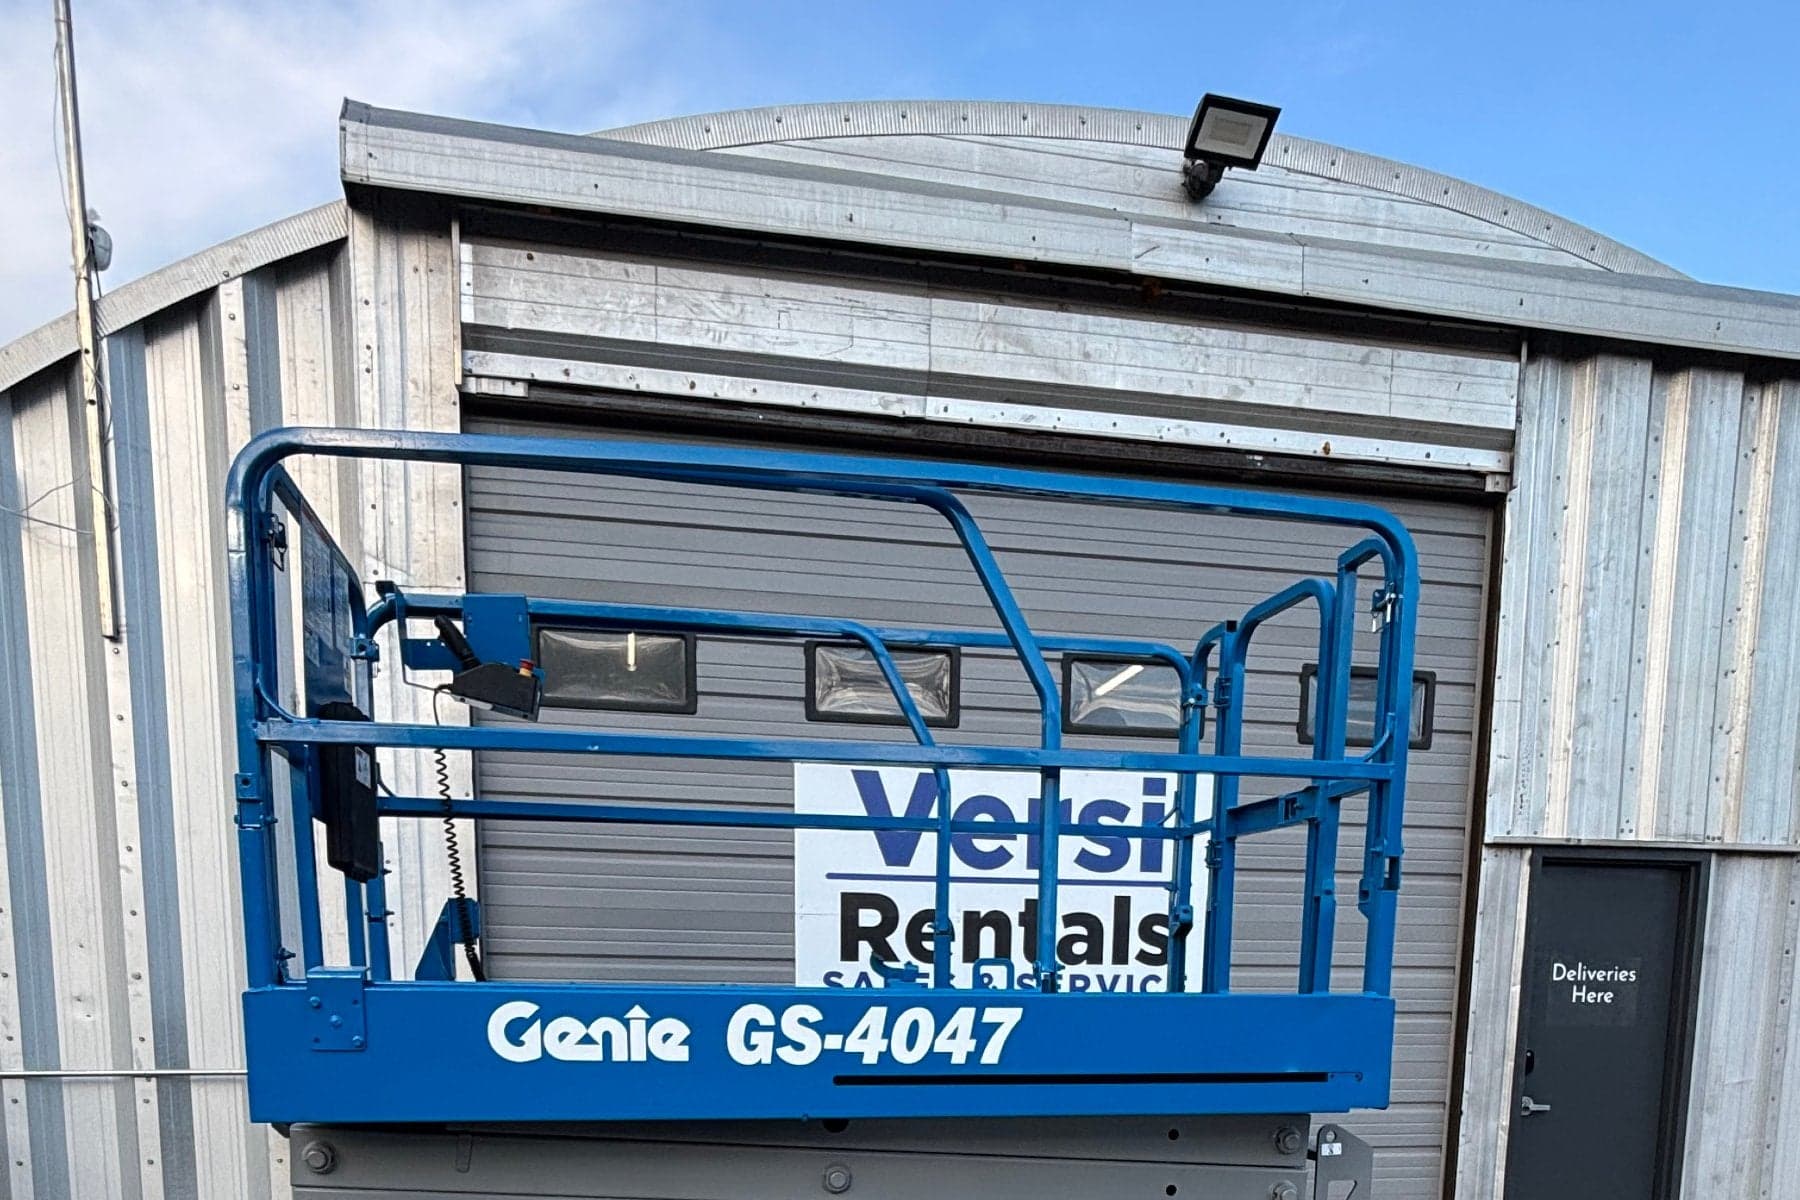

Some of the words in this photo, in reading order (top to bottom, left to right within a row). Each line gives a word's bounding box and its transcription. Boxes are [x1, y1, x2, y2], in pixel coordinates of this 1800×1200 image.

[851, 769, 1167, 874] Versi
[840, 892, 1168, 967] Rentals
[1553, 962, 1637, 981] Deliveries
[1572, 985, 1614, 1003] Here
[487, 1001, 691, 1063] Genie
[726, 1003, 1023, 1066] GS-4047
